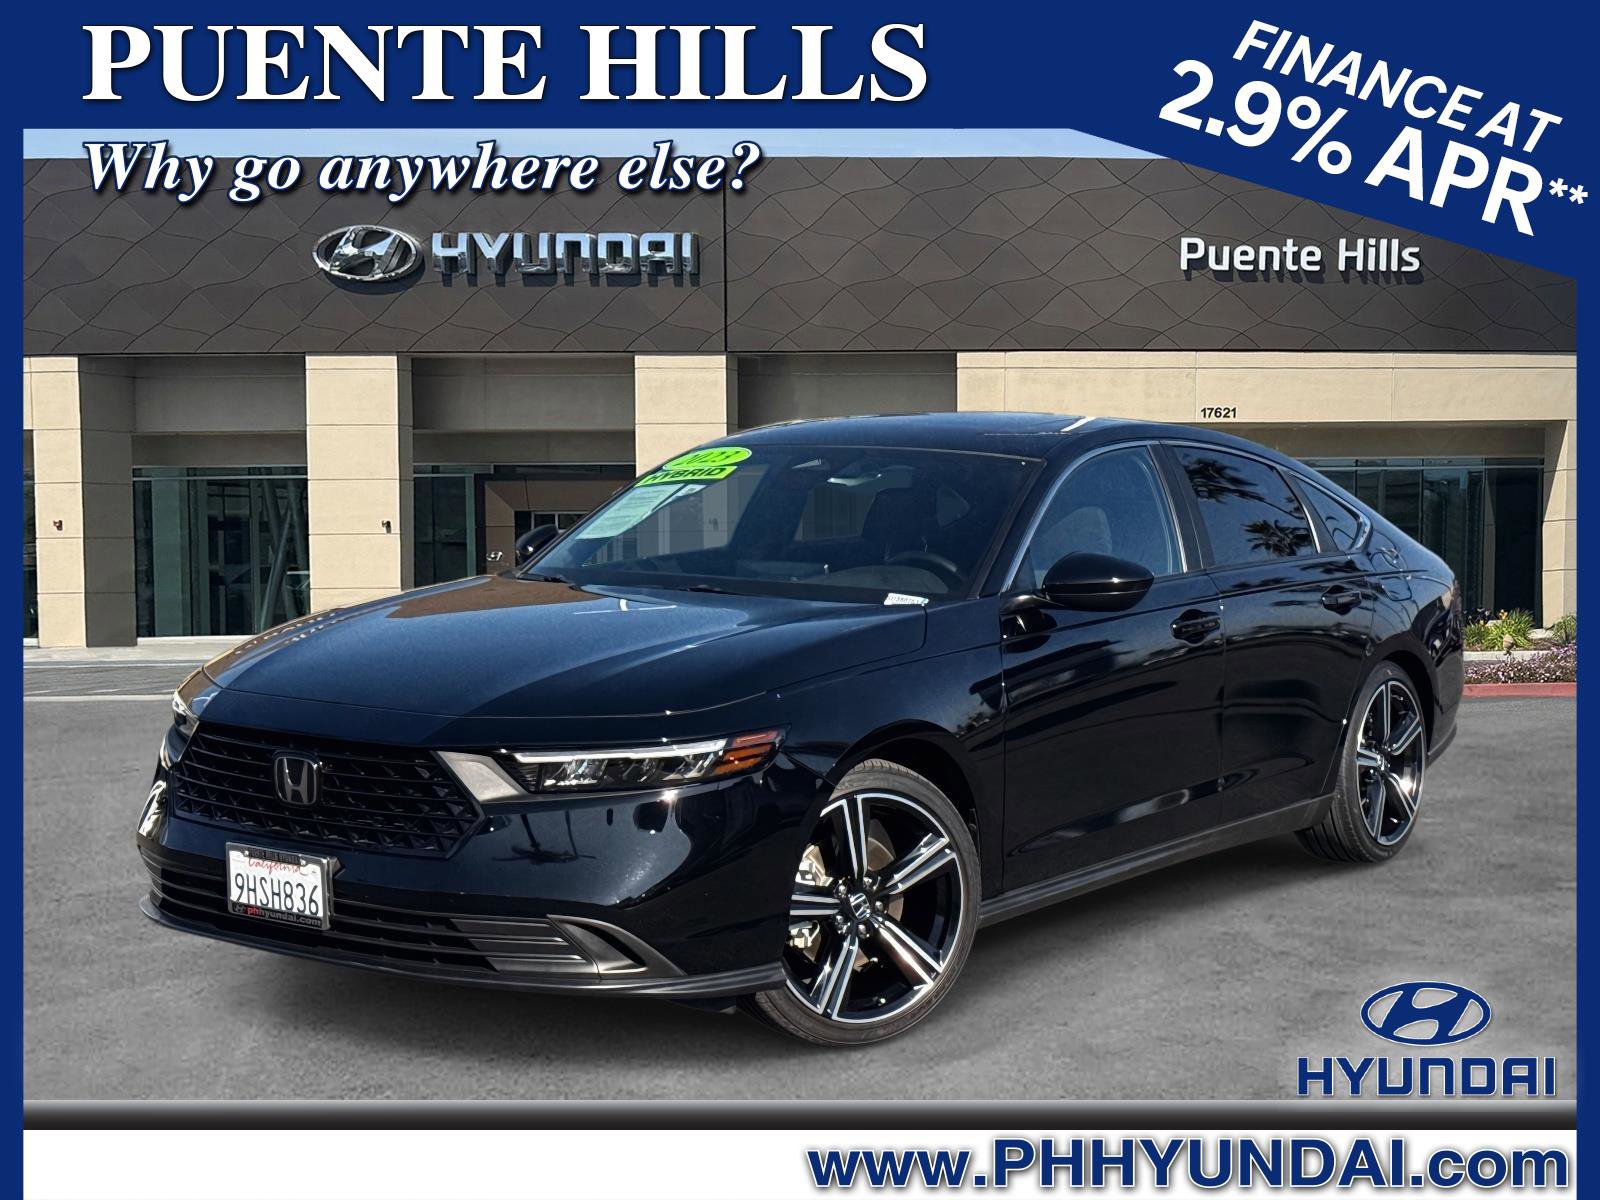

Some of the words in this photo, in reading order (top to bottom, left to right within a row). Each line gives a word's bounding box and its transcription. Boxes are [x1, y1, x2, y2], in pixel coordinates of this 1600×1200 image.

[432, 232, 700, 278] HYUNDAI
[1179, 236, 1323, 274] Puente
[1337, 236, 1421, 274] Hills
[1200, 406, 1238, 420] 17621
[643, 467, 723, 484] HYBRID
[234, 872, 319, 916] 9HSH836
[246, 904, 322, 927] phhyundai.com
